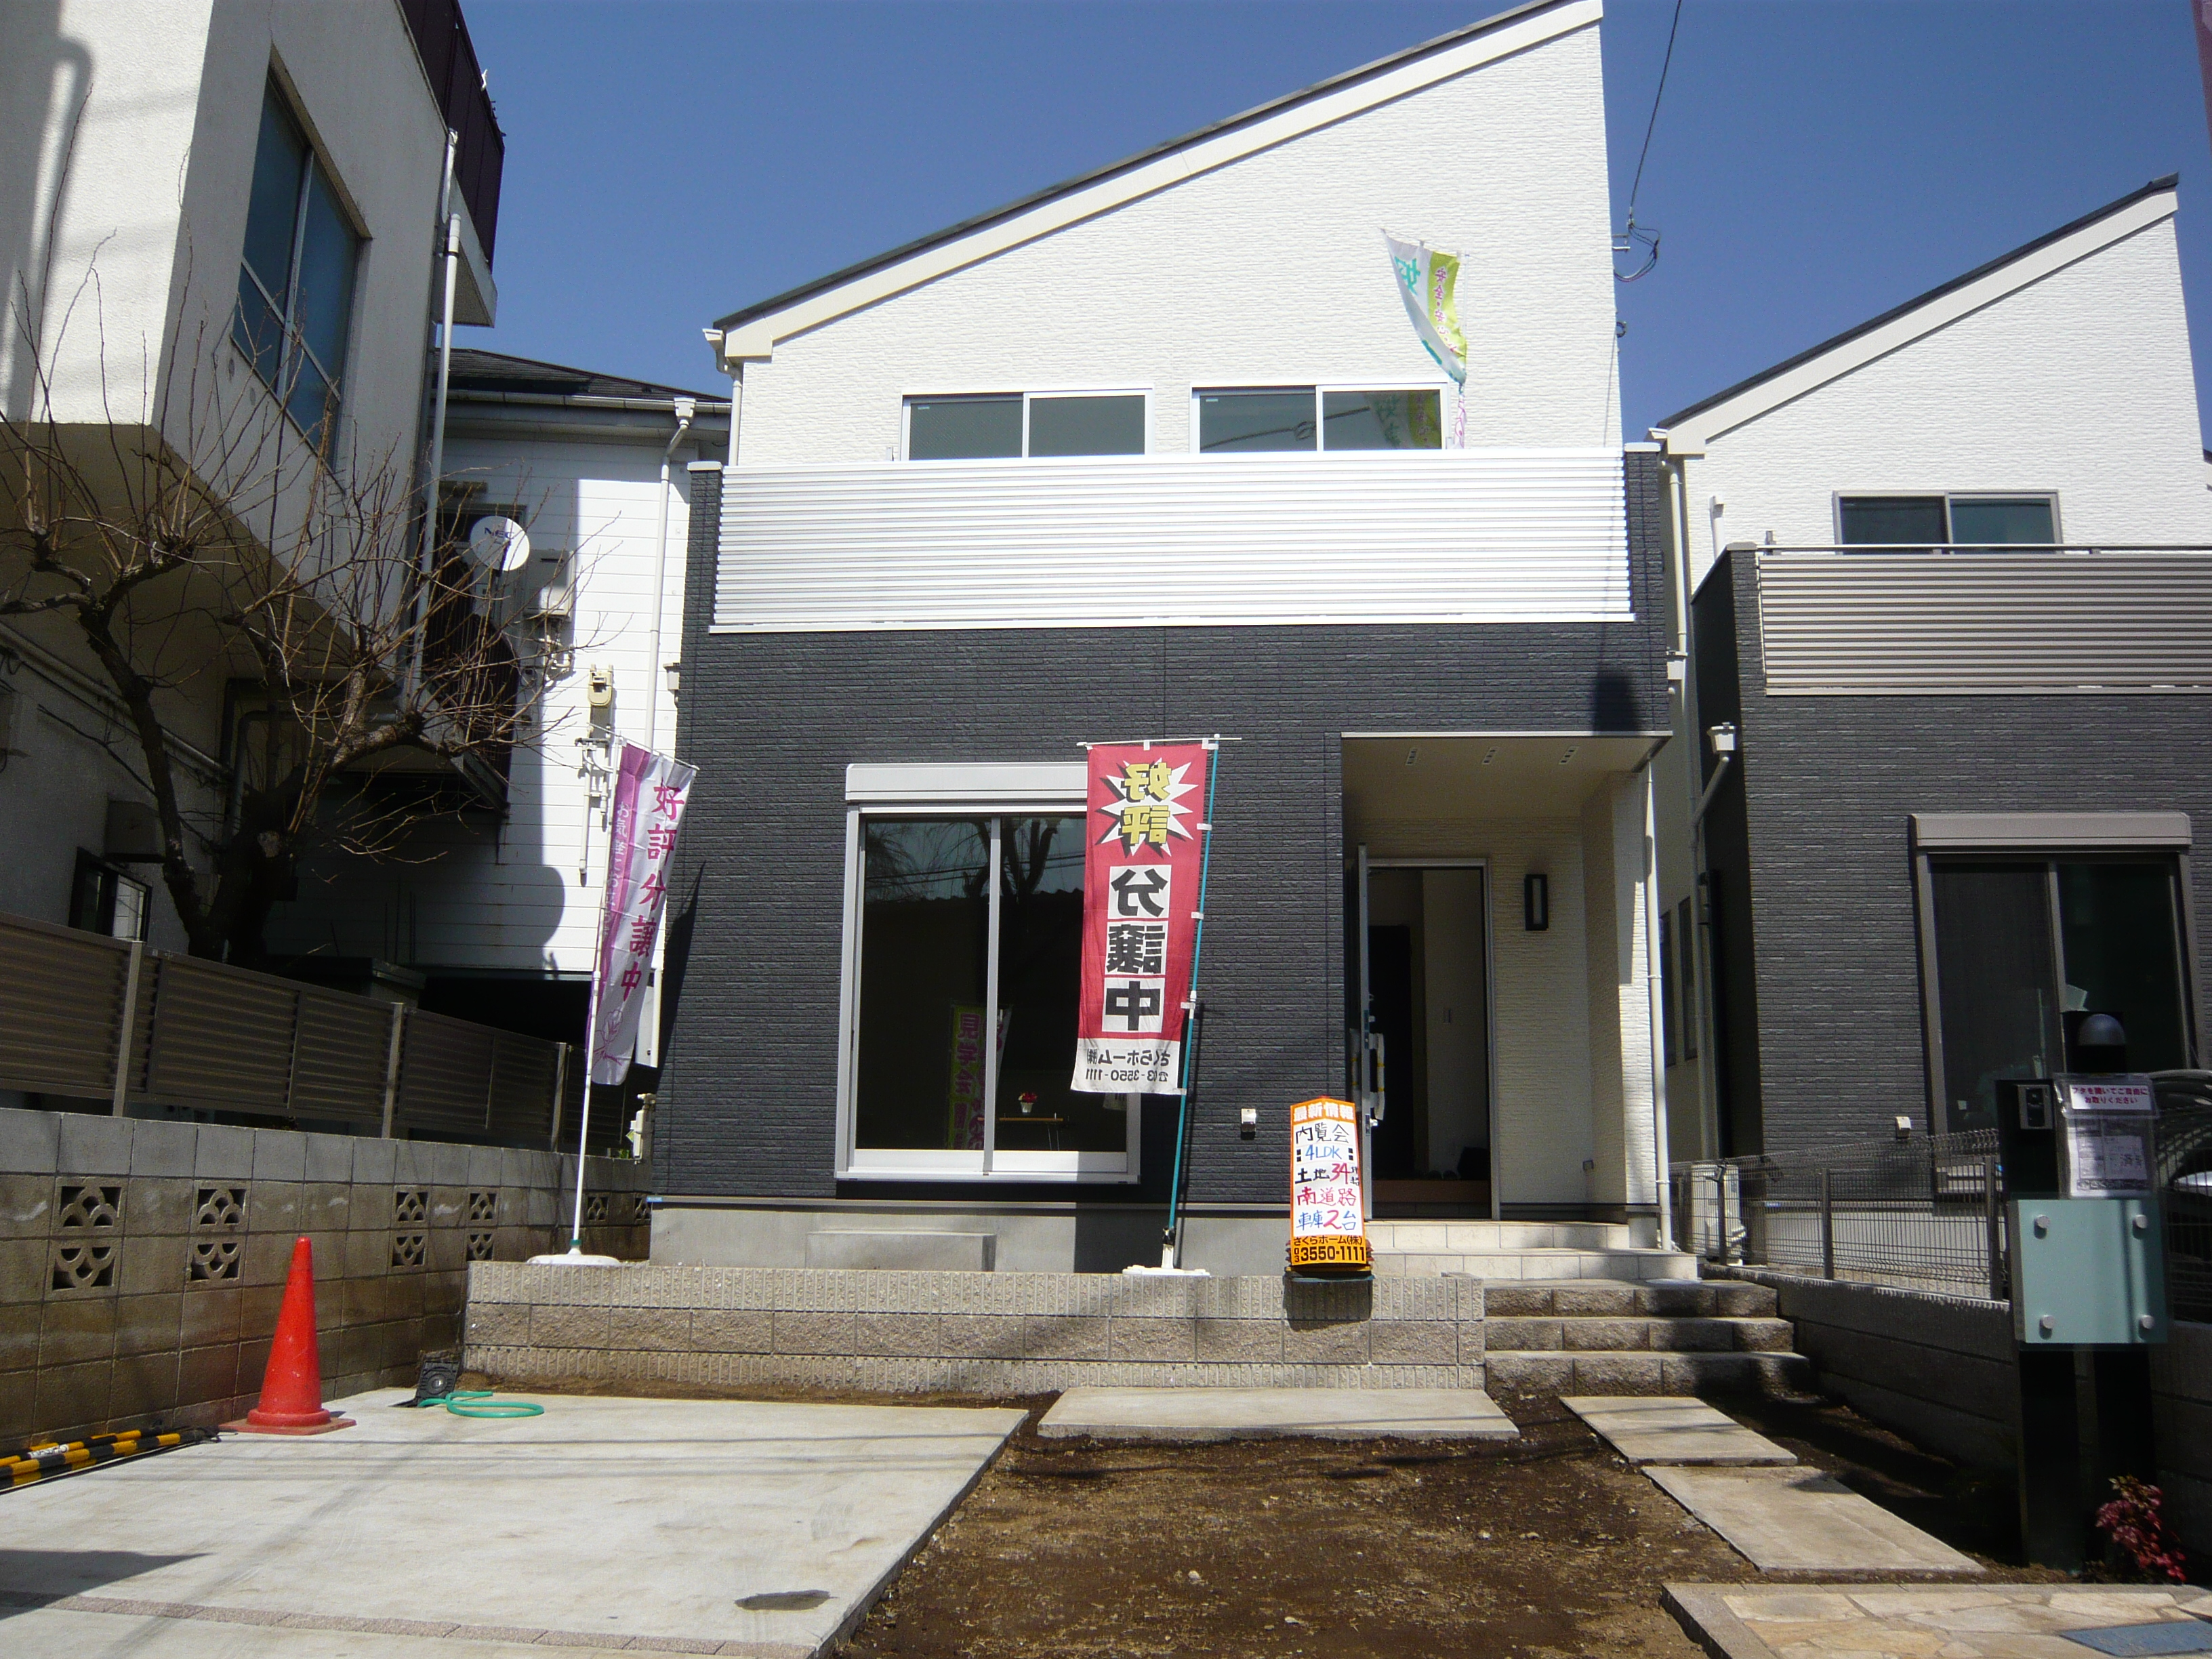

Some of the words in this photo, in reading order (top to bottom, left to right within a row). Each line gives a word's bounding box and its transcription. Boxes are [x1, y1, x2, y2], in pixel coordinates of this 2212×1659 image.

[485, 527, 515, 539] NEC
[620, 778, 685, 1002] 好評分譲中
[1293, 1101, 1354, 1122] 最新情報
[1295, 1122, 1349, 1145] 内覧会
[1305, 1144, 1342, 1161] 4LDK
[1296, 1185, 1357, 1207] 南道路
[1296, 1209, 1357, 1231] 車庫2台
[1300, 1245, 1366, 1262] 3550-1111
